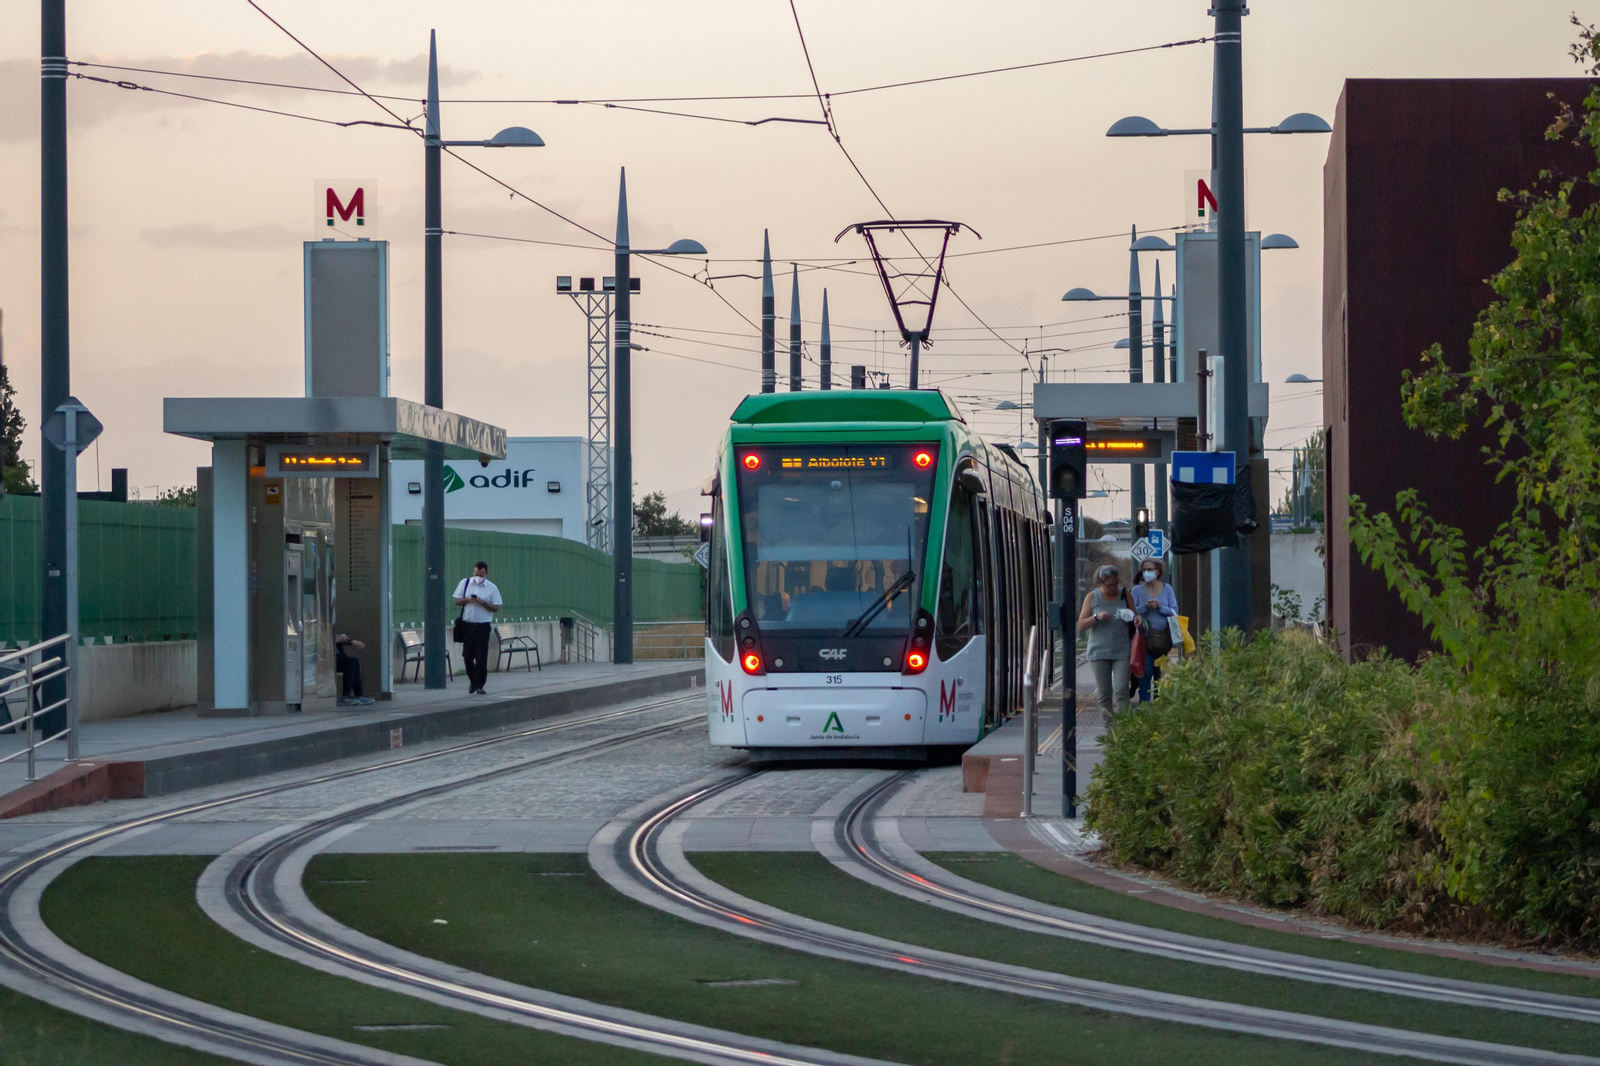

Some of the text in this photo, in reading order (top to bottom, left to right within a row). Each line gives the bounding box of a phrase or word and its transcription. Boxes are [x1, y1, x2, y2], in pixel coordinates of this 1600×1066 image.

[326, 187, 365, 226] M
[469, 468, 535, 489] adif
[1064, 507, 1072, 516] S
[1063, 516, 1073, 524] 04
[1063, 524, 1074, 533] 06
[1136, 546, 1149, 556] 30
[818, 648, 847, 660] CAF
[826, 675, 843, 684] 315
[720, 679, 734, 723] M
[939, 678, 956, 723] M
